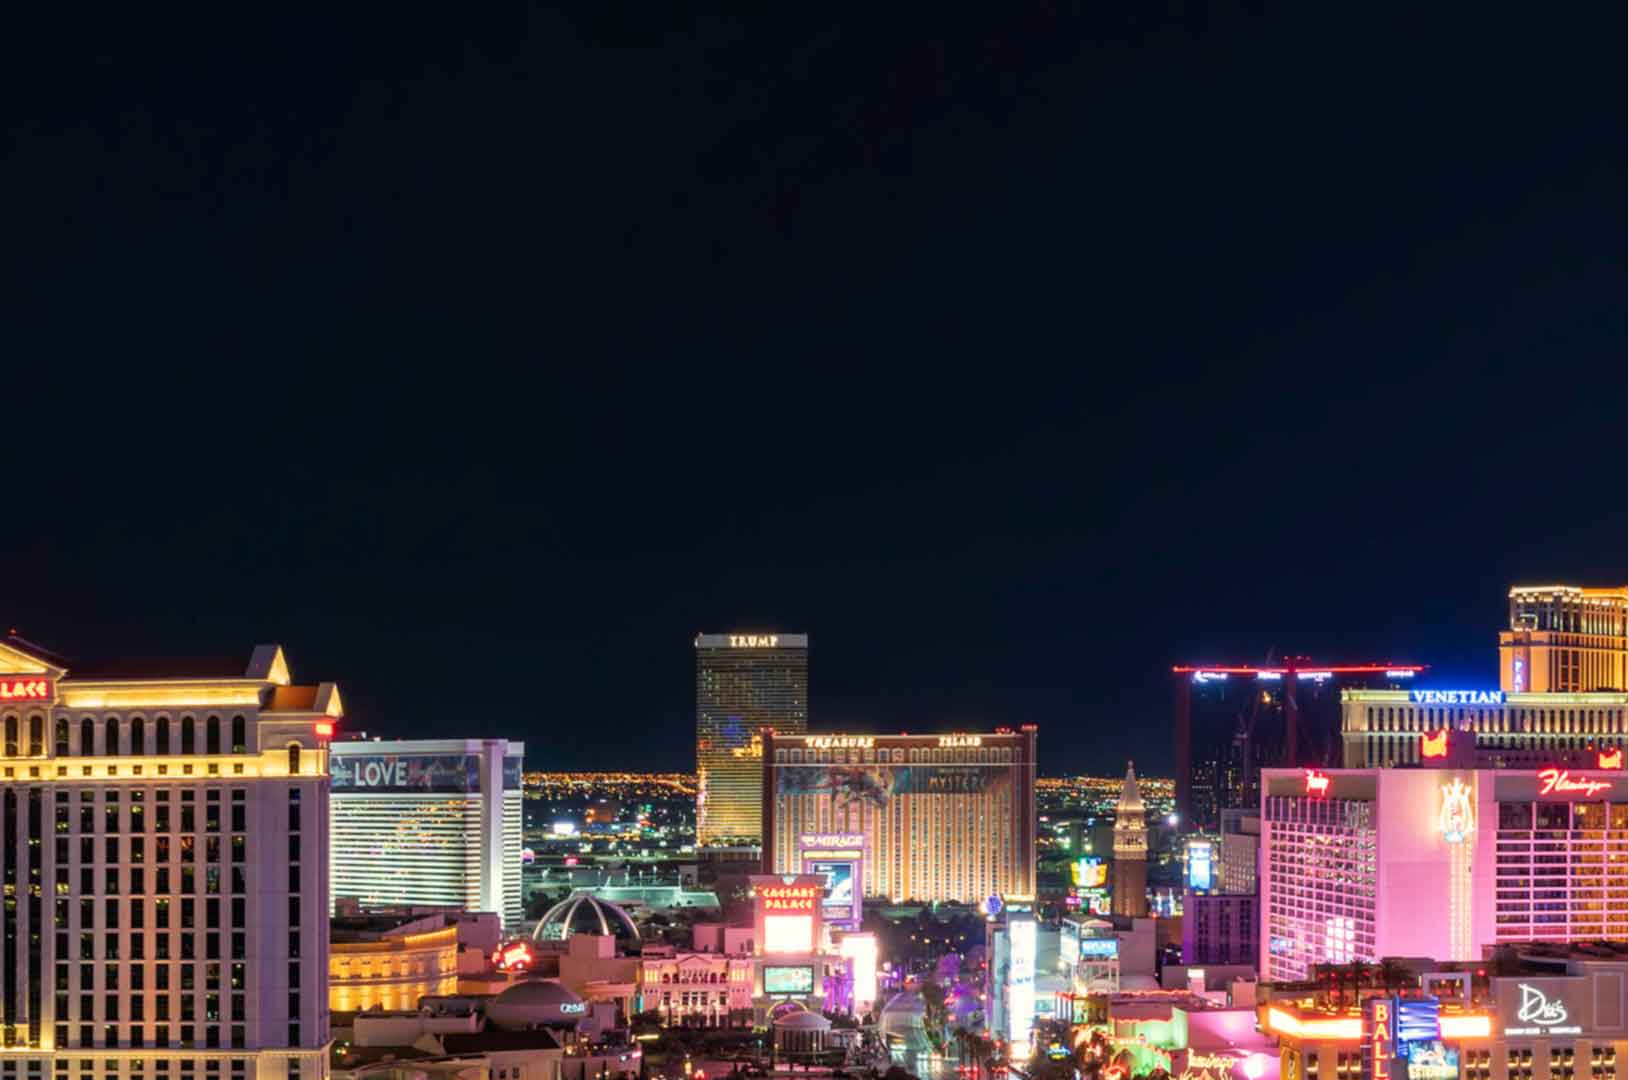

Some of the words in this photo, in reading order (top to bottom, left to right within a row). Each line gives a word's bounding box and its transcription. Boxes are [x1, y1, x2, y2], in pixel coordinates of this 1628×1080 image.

[730, 635, 778, 648] TRUMP
[1413, 690, 1501, 704] VENETIAN
[805, 736, 874, 748] TREASURE
[938, 736, 982, 747] ISLAND
[354, 762, 407, 786] LOVE
[762, 887, 815, 898] CAESARS
[765, 899, 812, 909] PALACE
